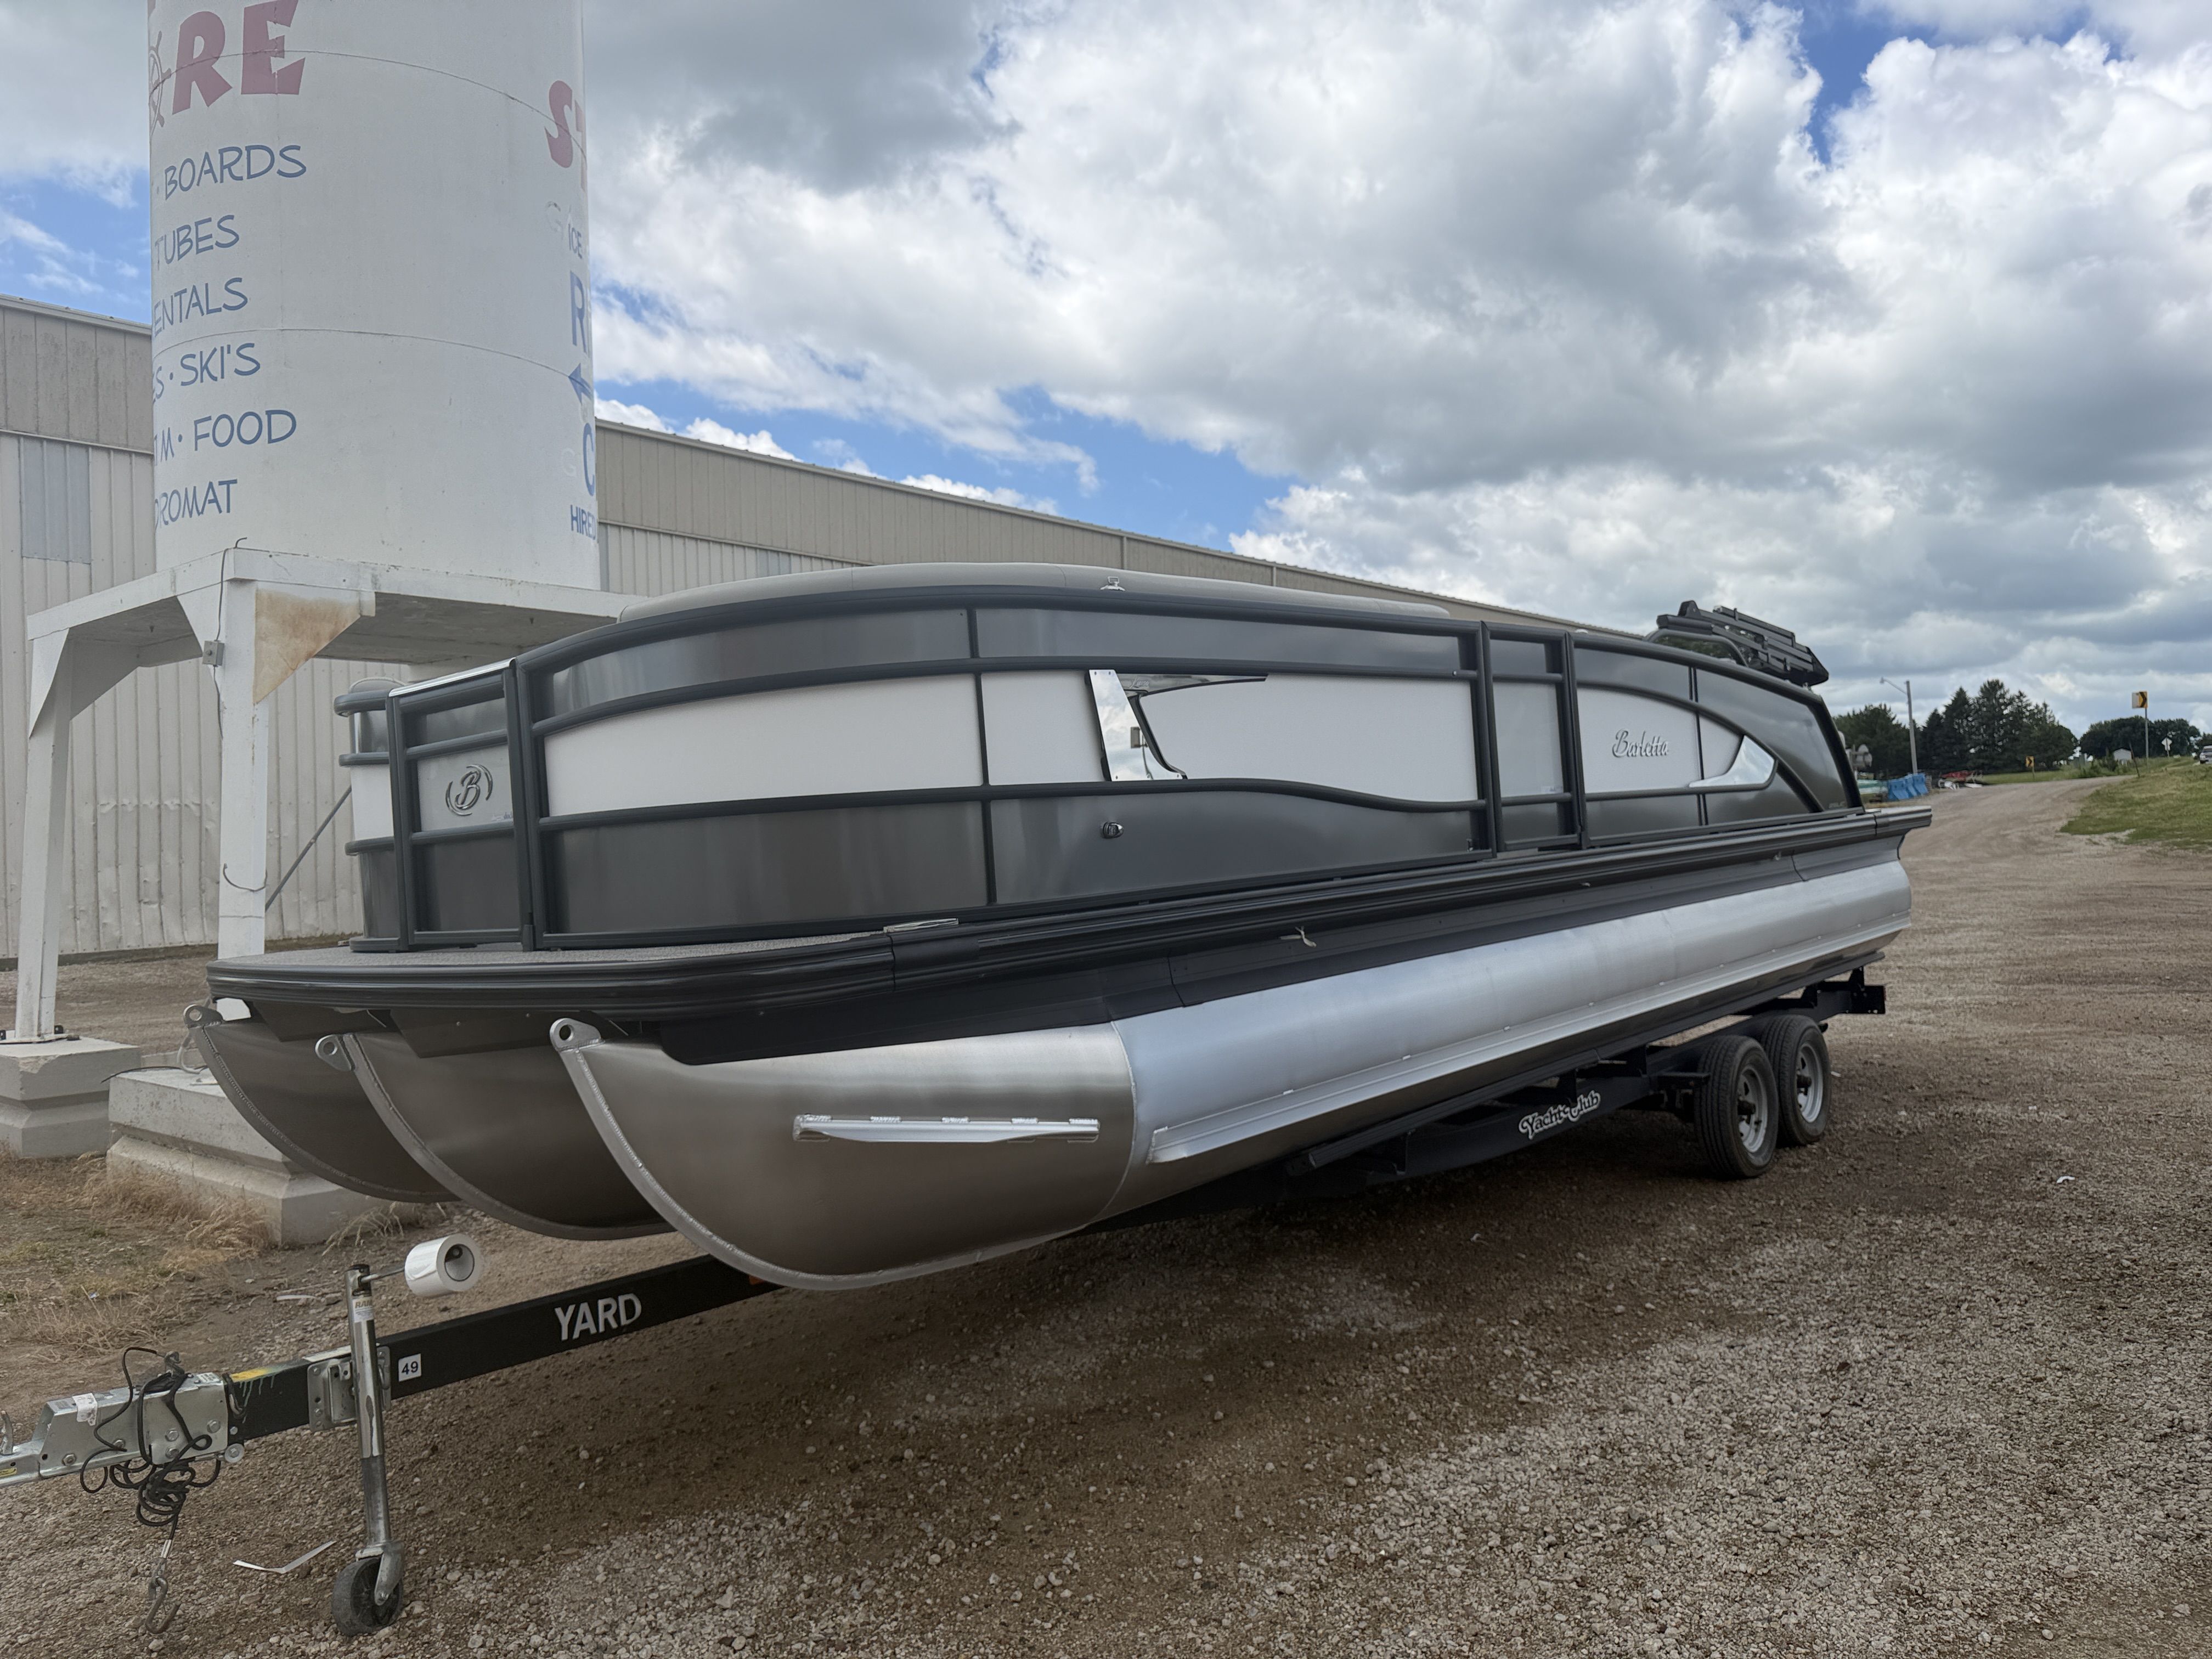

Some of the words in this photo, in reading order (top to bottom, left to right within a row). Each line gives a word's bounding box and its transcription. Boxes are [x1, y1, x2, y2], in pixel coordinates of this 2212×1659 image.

[164, 144, 307, 201] BOARDS
[154, 215, 240, 271] TUBES
[180, 342, 261, 386] SKI'S
[194, 409, 297, 452] FOOD
[1612, 729, 1669, 758] Barletta
[1519, 1105, 1566, 1140] Yacht
[555, 1293, 642, 1341] YARD
[401, 1361, 419, 1375] 49
